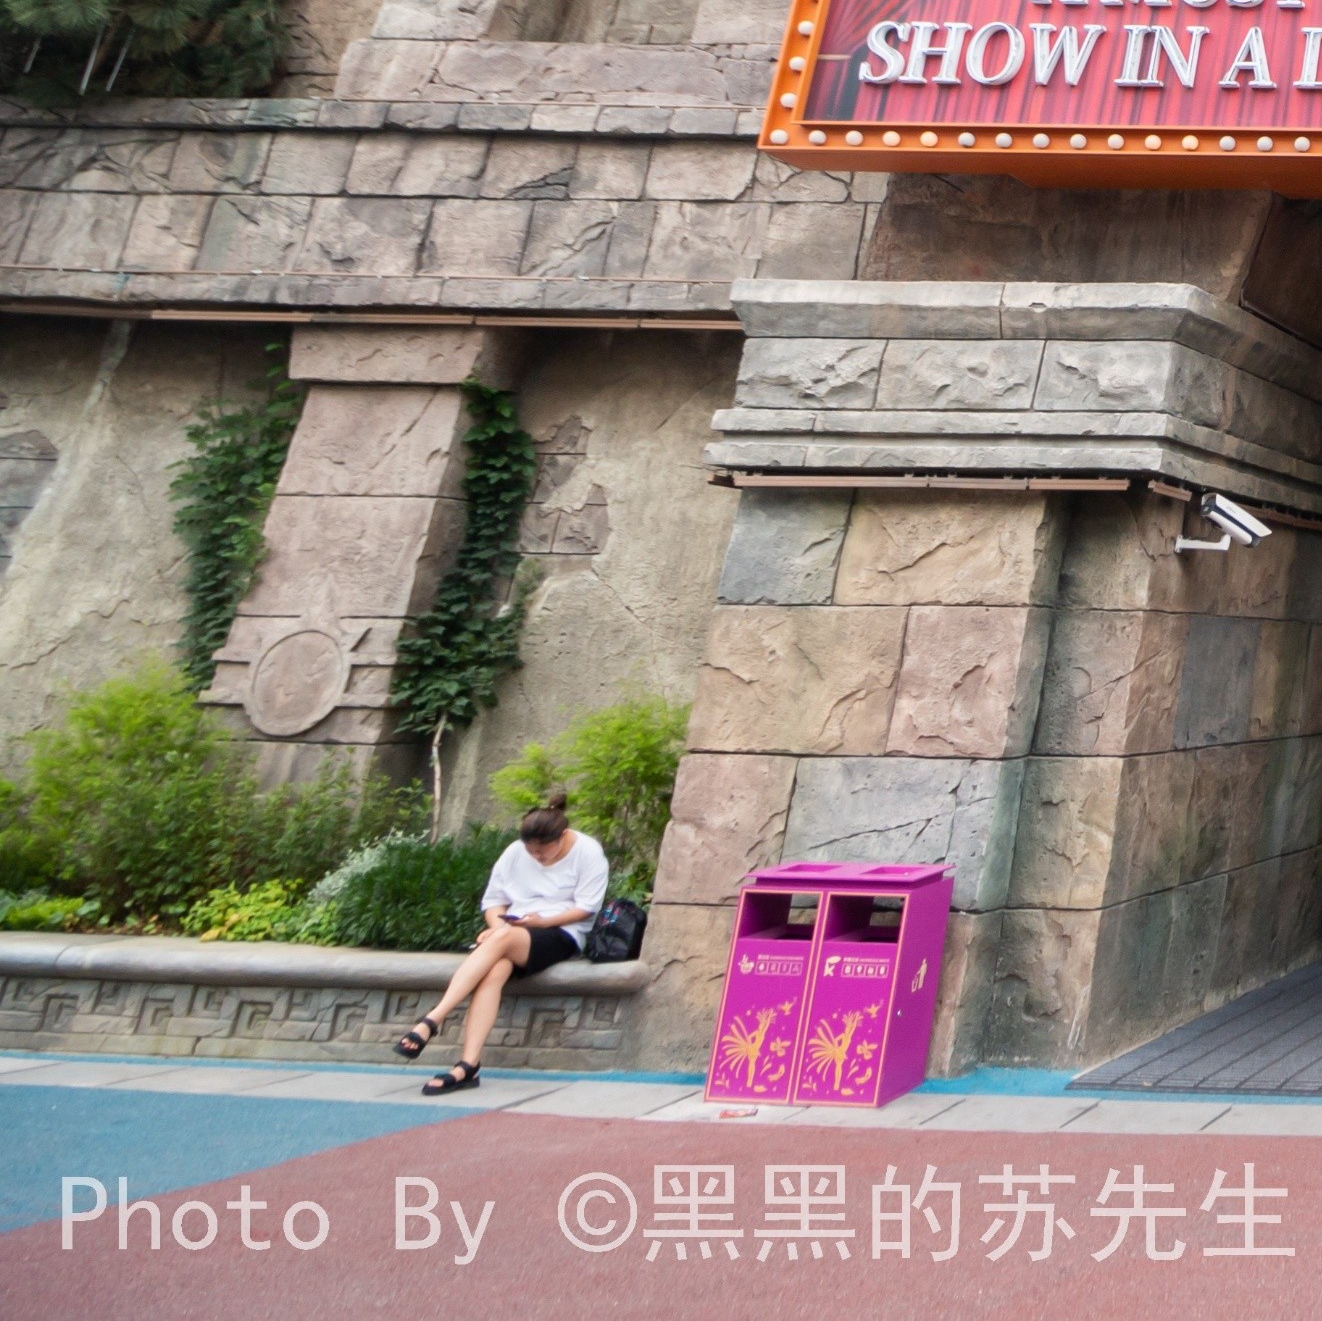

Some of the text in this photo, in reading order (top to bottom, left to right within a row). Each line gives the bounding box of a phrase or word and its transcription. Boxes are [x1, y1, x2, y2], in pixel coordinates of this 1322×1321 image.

[858, 20, 1106, 87] SHOW
[1115, 24, 1211, 90] IN
[1220, 25, 1279, 90] A
